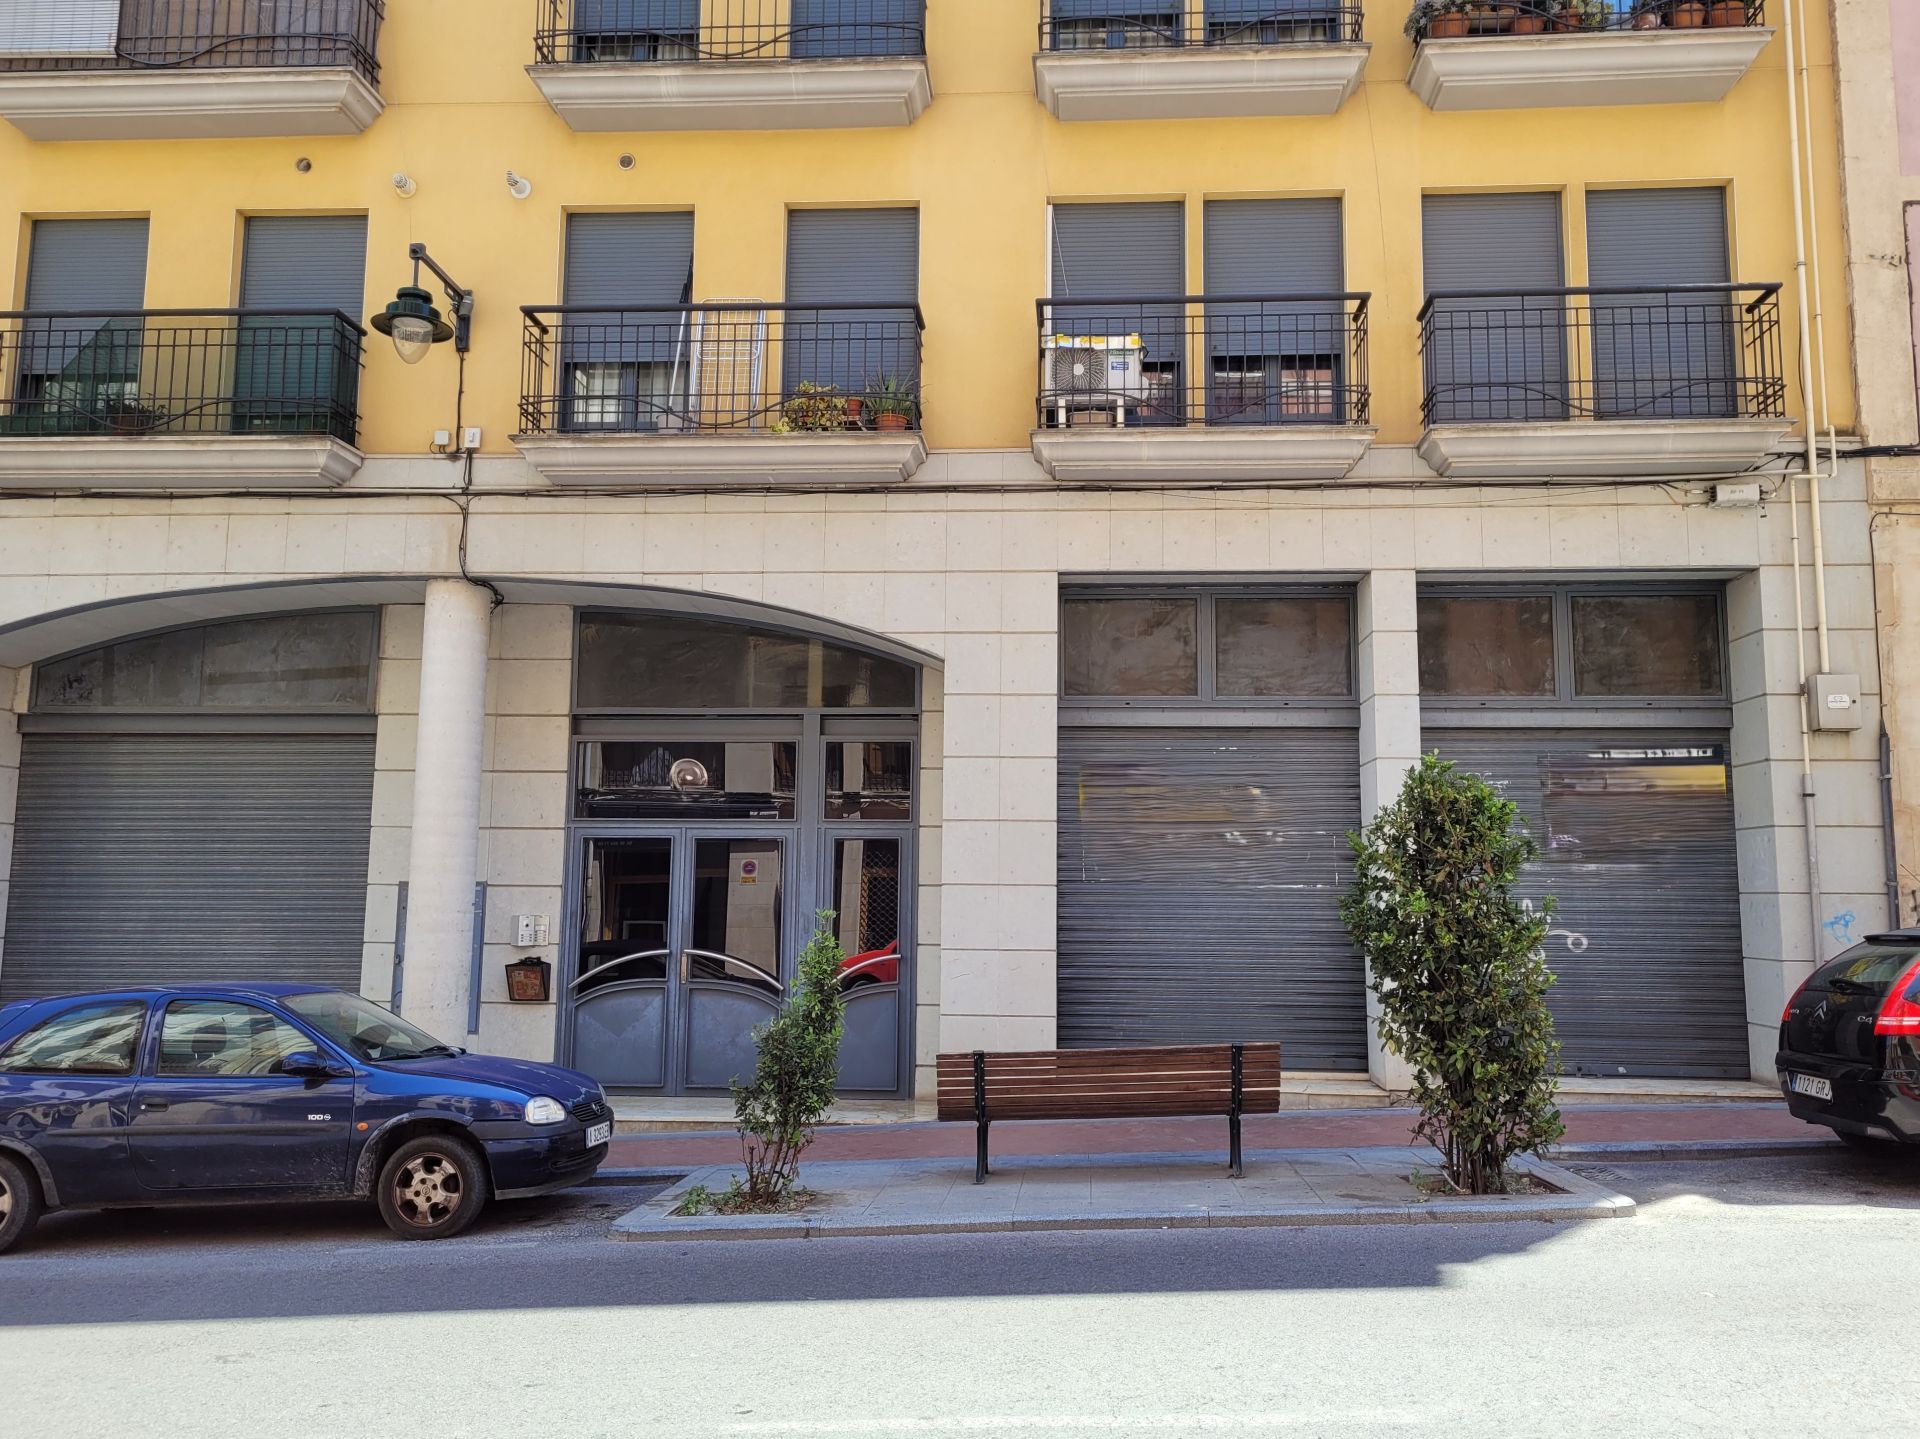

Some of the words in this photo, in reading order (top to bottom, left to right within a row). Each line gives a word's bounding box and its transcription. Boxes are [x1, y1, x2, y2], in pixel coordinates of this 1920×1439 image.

[1857, 1015, 1873, 1024] C4
[1798, 1076, 1814, 1093] 1121
[1816, 1080, 1831, 1097] GRJ
